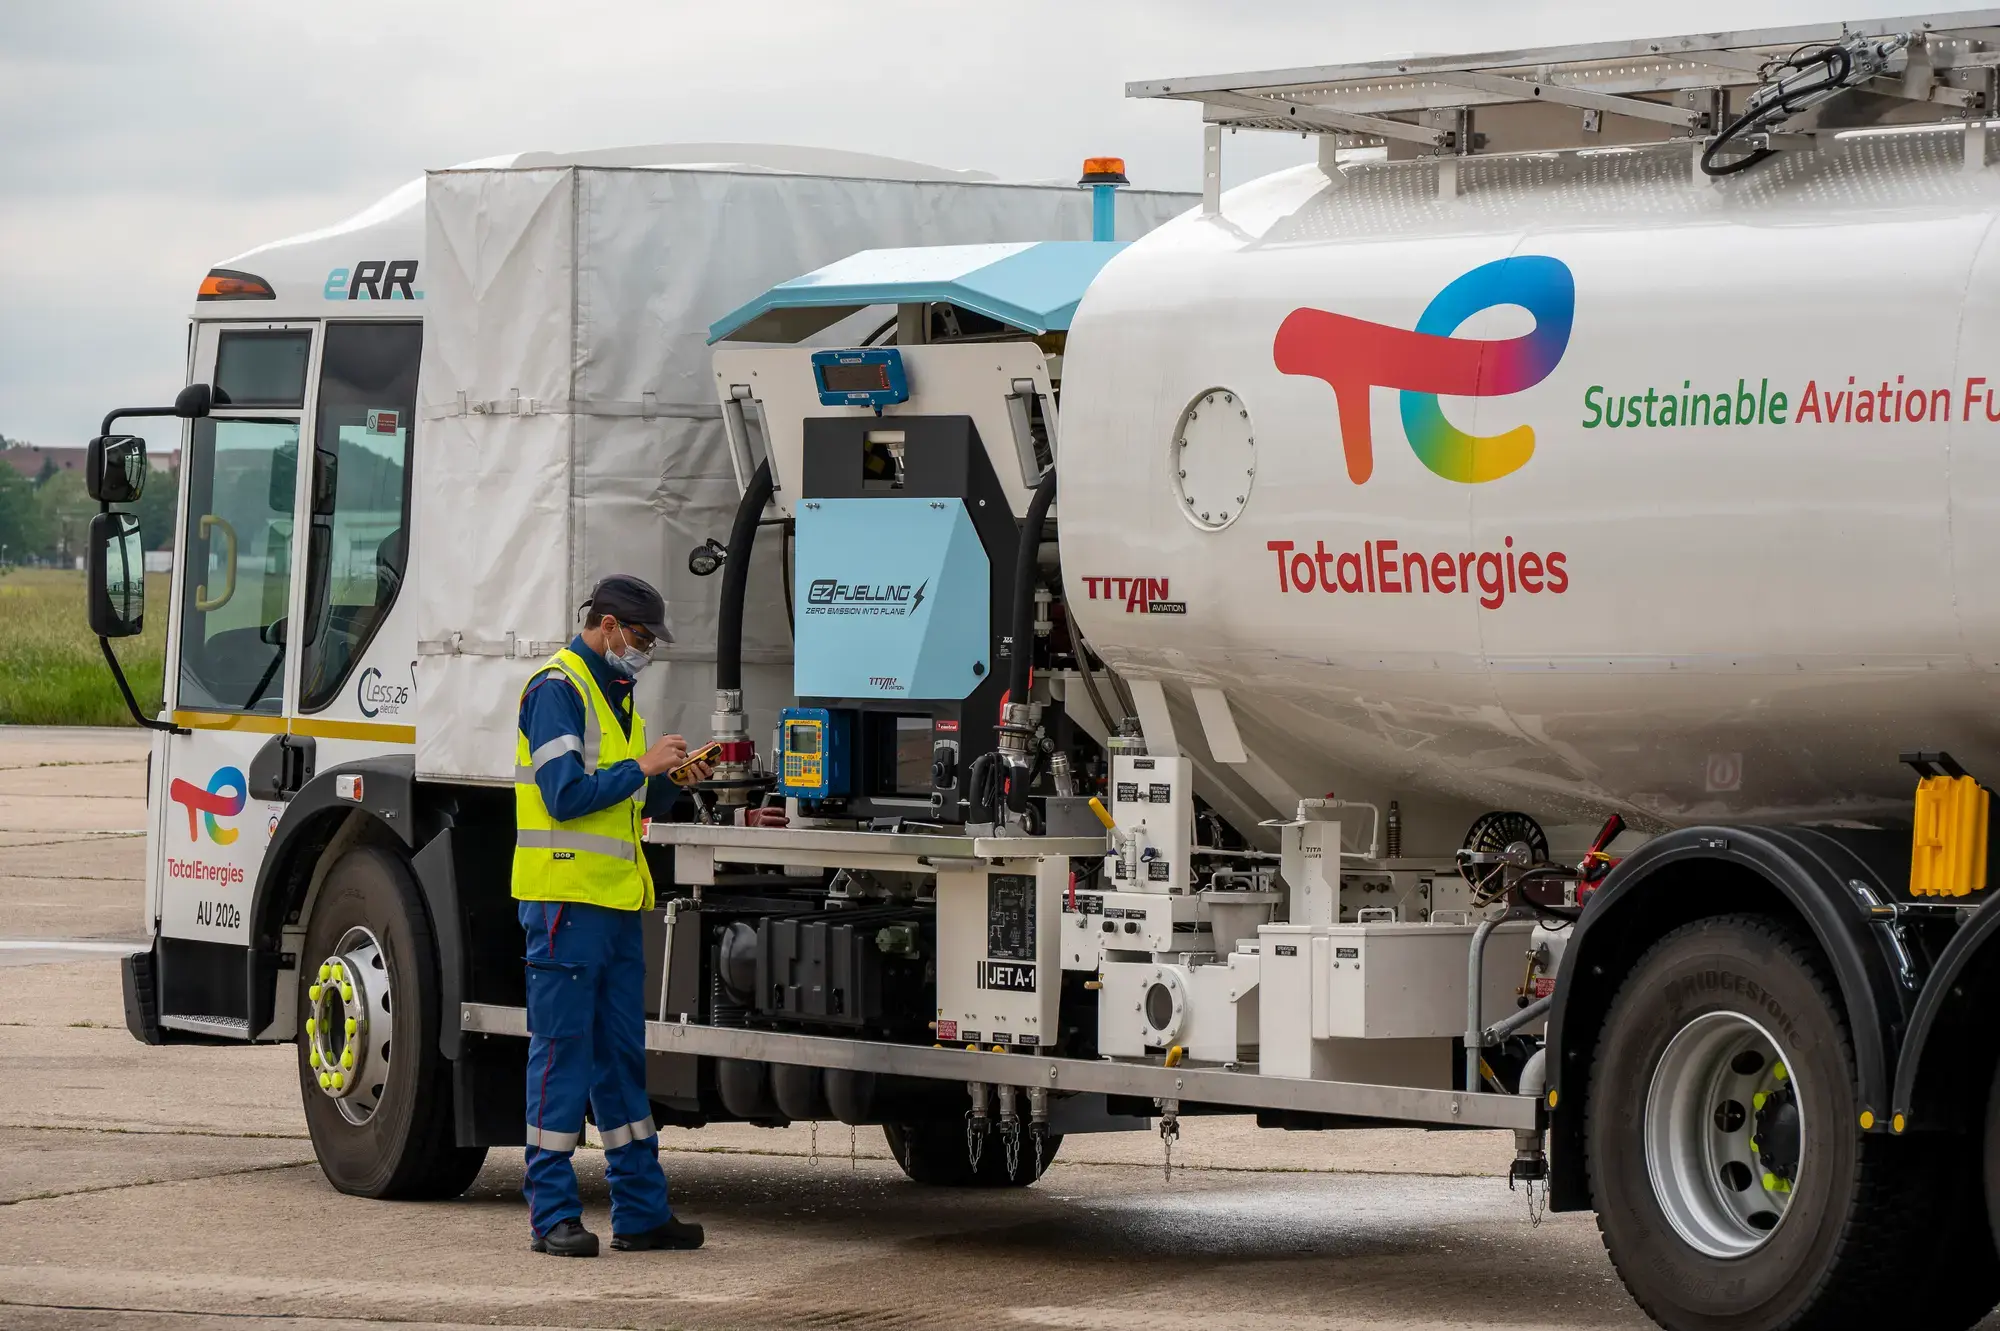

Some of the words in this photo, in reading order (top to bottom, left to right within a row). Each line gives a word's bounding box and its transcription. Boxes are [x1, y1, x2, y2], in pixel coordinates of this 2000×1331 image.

[1582, 378, 1788, 428] Sustainable
[1795, 375, 1951, 423] Aviation
[1267, 535, 1568, 609] TotalEnergies
[834, 585, 911, 601] FUELLING
[1082, 577, 1168, 613] TITAN
[805, 607, 826, 615] ZERO
[827, 607, 861, 615] EMISSION
[861, 607, 879, 615] INTO
[880, 607, 906, 615] PLANE
[1151, 603, 1184, 612] AVIATION
[167, 858, 244, 887] TotalEnergies
[196, 901, 212, 925] AU
[215, 902, 240, 929] 202e
[989, 966, 1014, 986] JET
[1014, 968, 1034, 987] A-1
